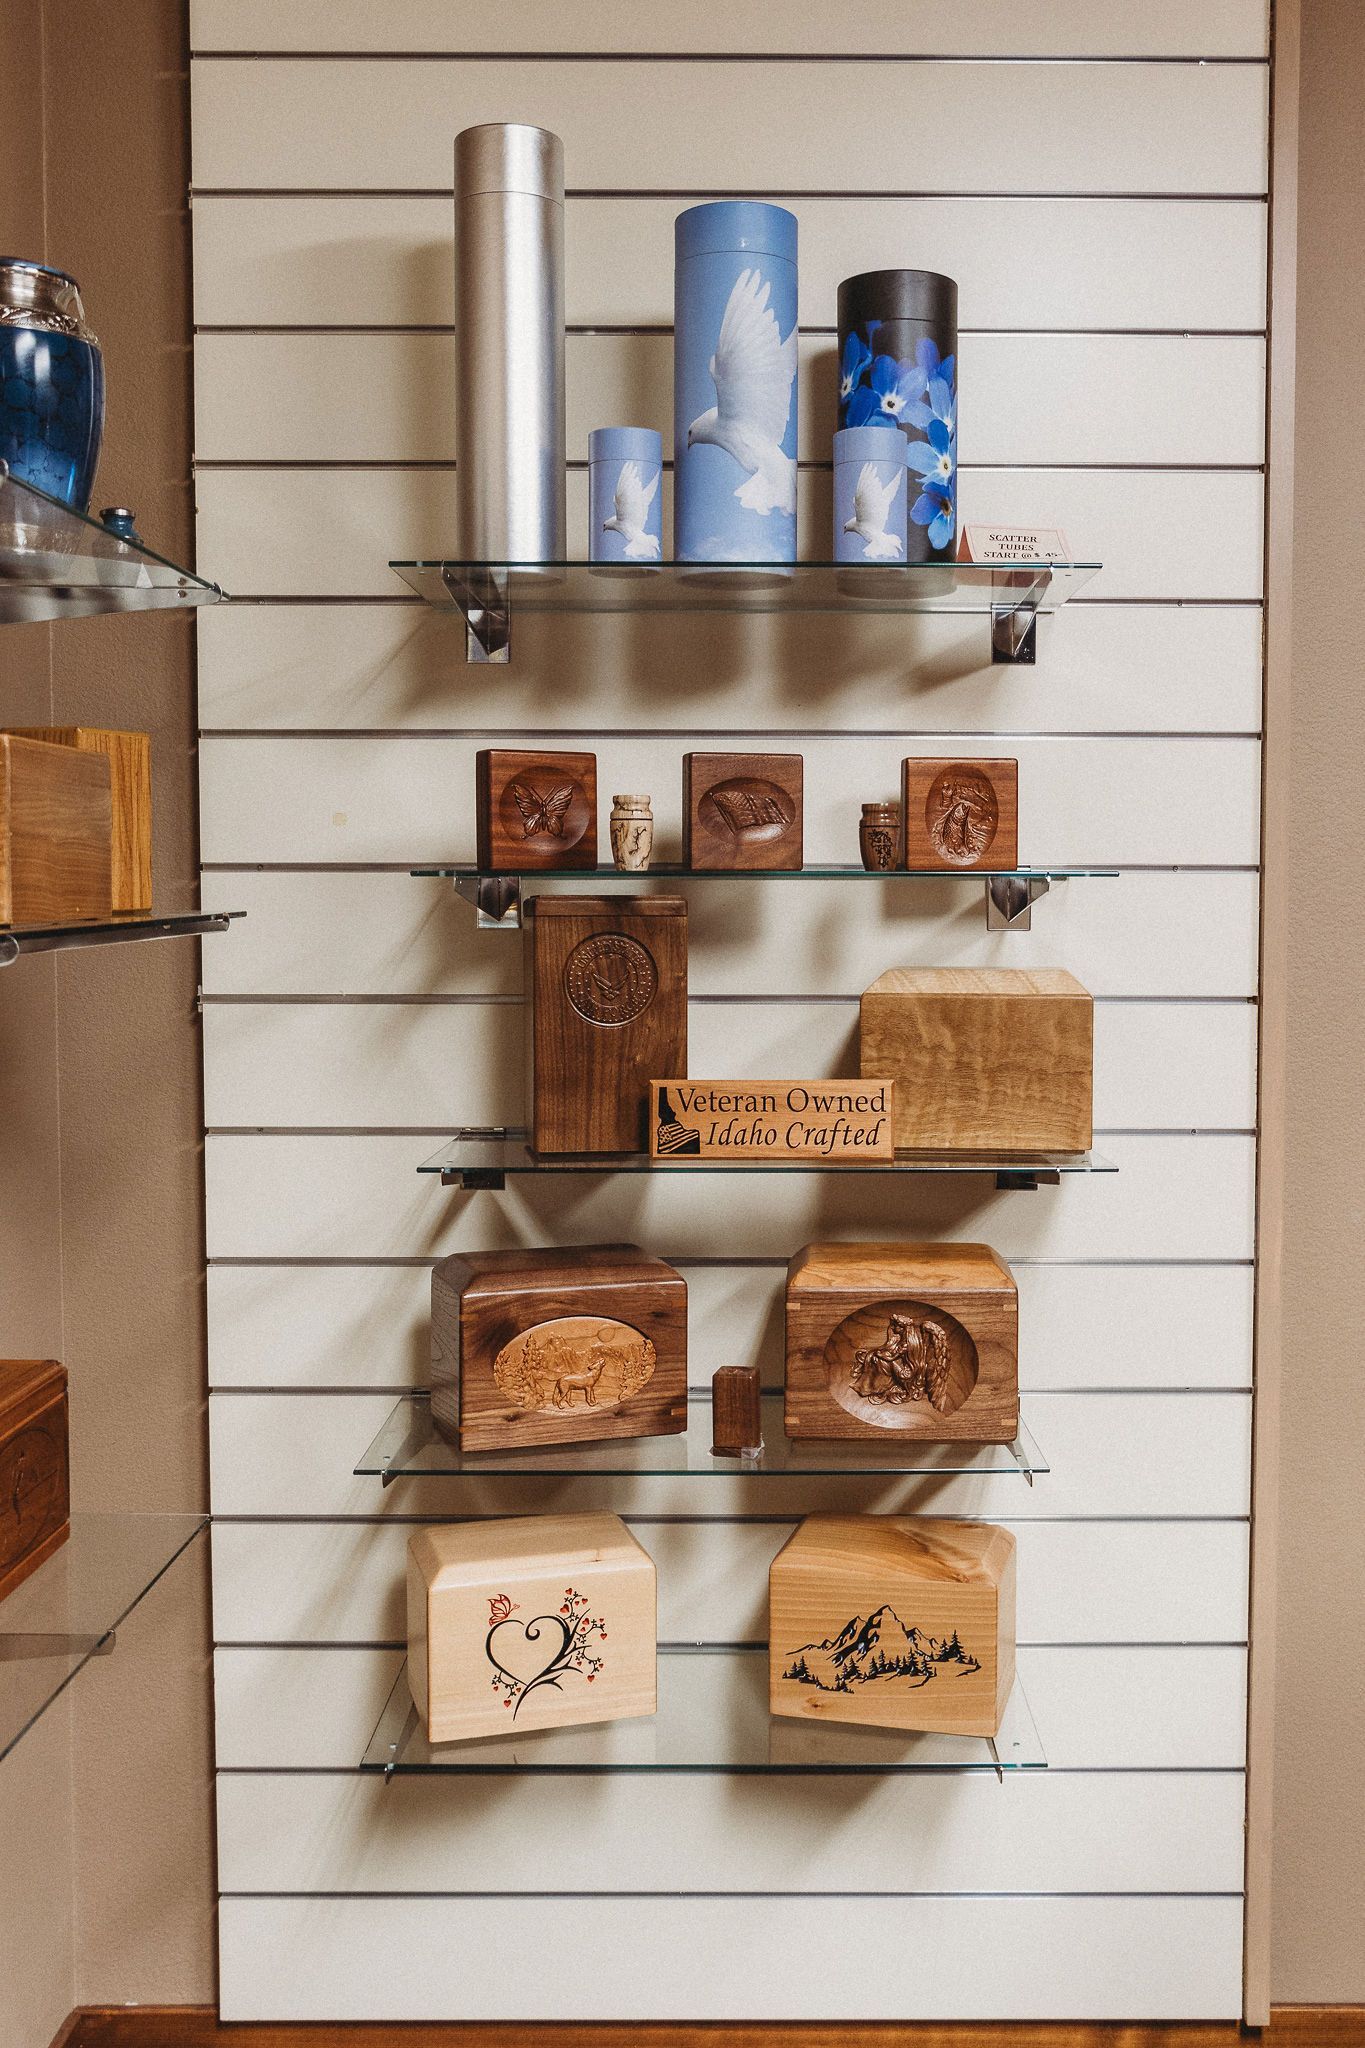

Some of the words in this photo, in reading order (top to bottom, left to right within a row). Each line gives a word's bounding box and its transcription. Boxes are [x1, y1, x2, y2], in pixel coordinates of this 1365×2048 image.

[989, 534, 1037, 543] SCATTER
[998, 543, 1034, 551] TUBES
[984, 551, 1018, 559] START
[676, 1088, 777, 1113] Veteran
[787, 1087, 887, 1113] Owned
[705, 1118, 777, 1146] Idaho
[785, 1118, 886, 1155] Crafted
